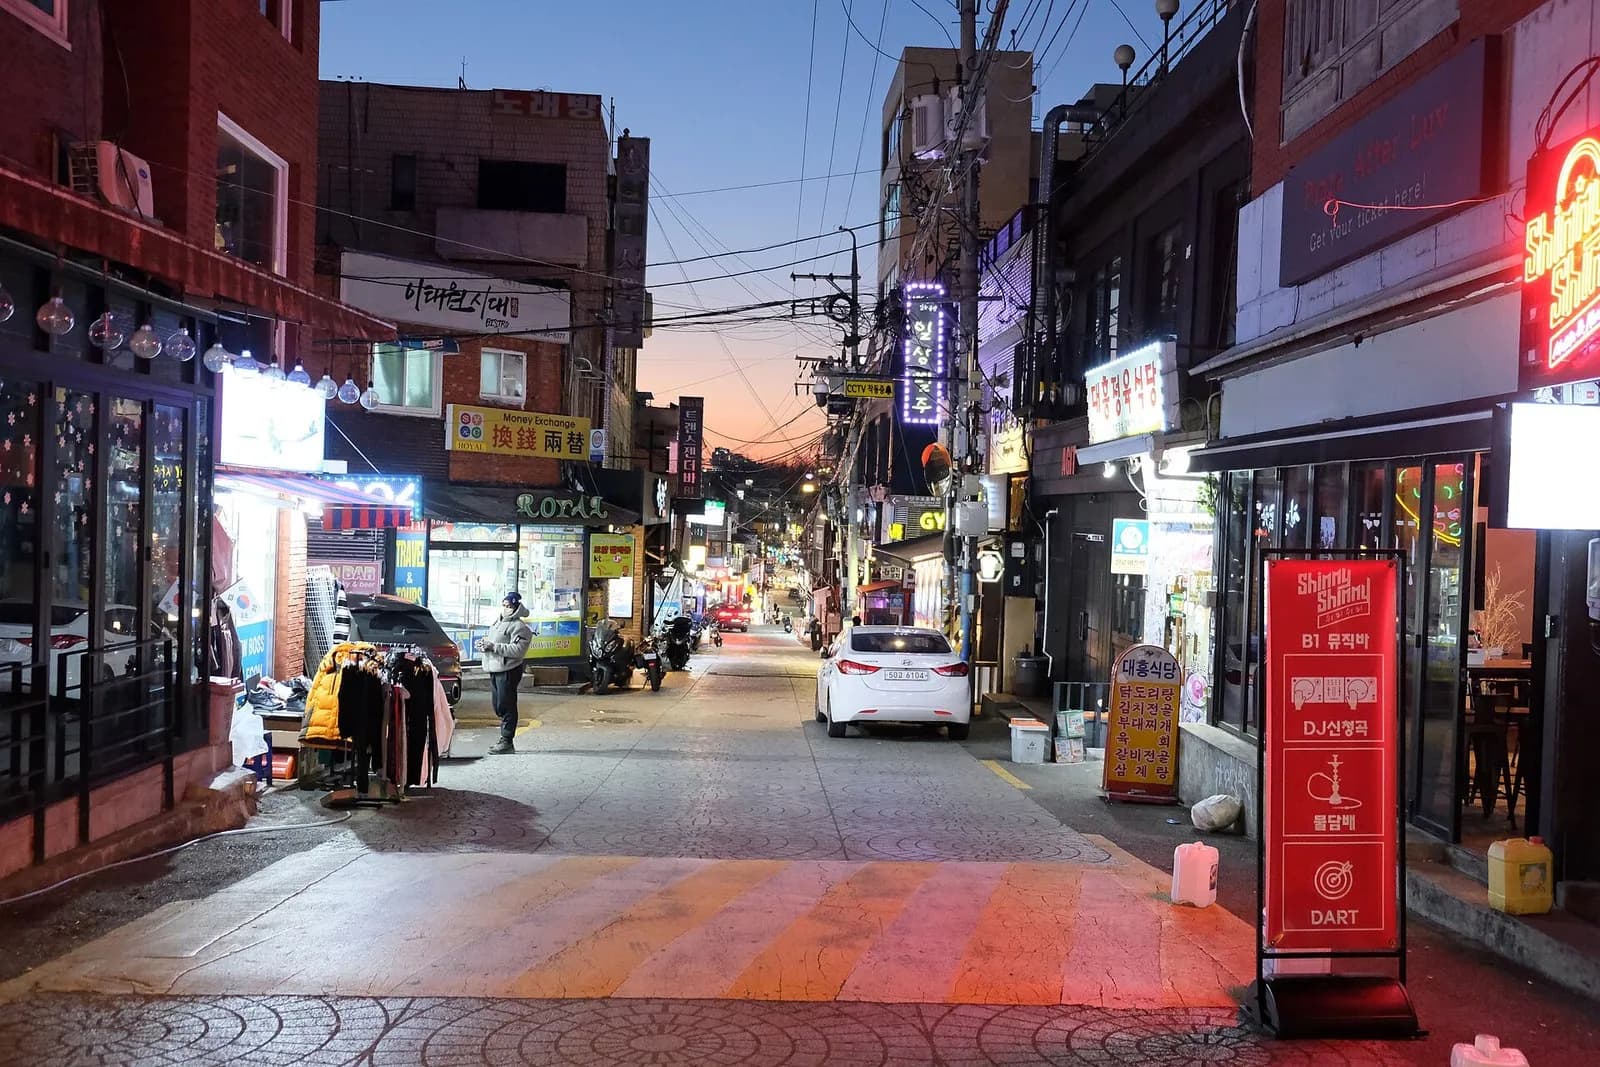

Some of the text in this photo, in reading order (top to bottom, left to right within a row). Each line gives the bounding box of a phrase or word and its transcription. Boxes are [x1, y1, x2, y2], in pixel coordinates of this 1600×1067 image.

[495, 91, 600, 118] 노래방
[1310, 172, 1427, 252] Get your ticket here!
[486, 318, 510, 328] BISTRO
[847, 384, 866, 394] CCTV
[503, 413, 576, 429] Money Exchange
[458, 442, 483, 451] ROYAL
[396, 540, 425, 568] TRAVEL
[343, 565, 376, 580] BAR
[406, 571, 413, 584] &
[1302, 633, 1370, 650] B1 뮤직바
[905, 671, 925, 679] 6104
[1122, 659, 1177, 680] 대흥식당
[1118, 701, 1174, 717] 김치전골
[1117, 716, 1173, 732] 부대찌개
[1303, 720, 1368, 737] DJ신청곡
[1115, 748, 1170, 763] 갈비전골
[1313, 814, 1356, 832] 물담배
[1311, 910, 1359, 925] DART
